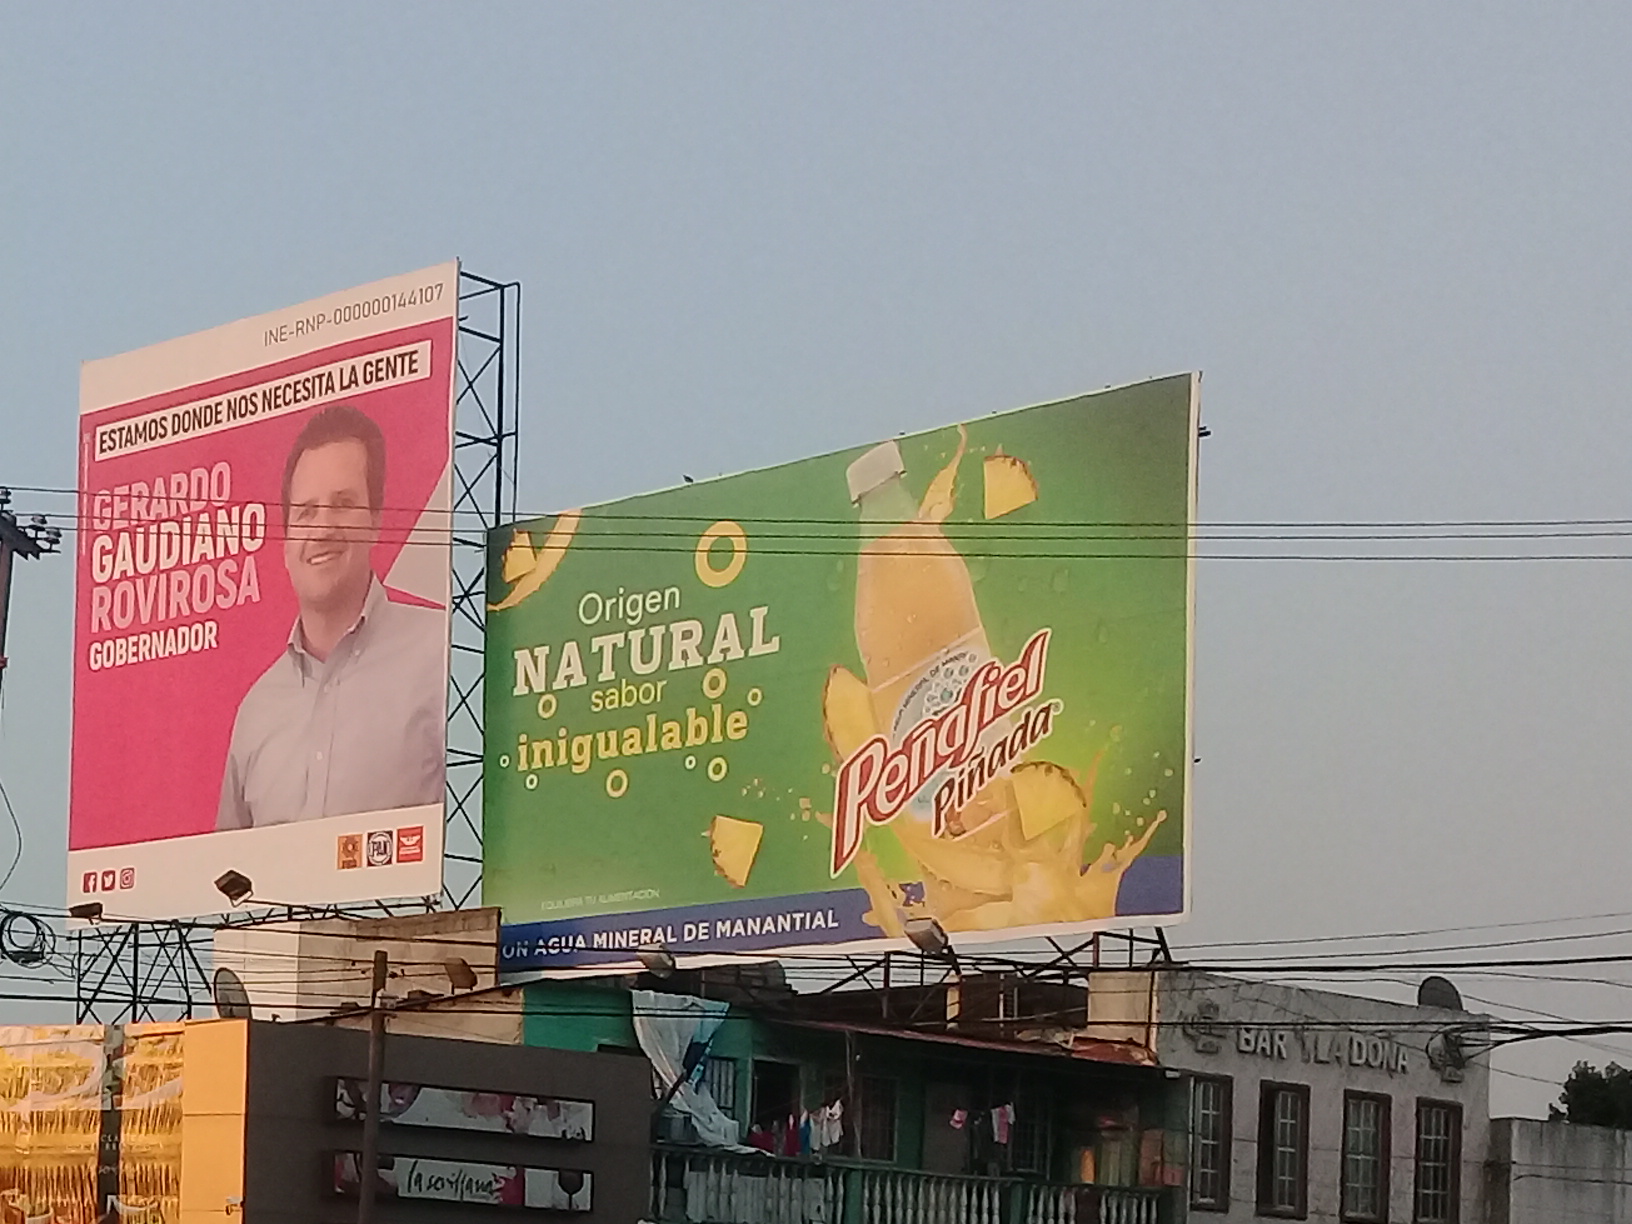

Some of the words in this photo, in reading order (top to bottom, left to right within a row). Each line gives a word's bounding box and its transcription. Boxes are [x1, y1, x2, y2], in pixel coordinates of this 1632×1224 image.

[264, 283, 443, 346] INE-RNP-000000144107
[99, 415, 168, 455] ESTAMOS
[171, 400, 224, 437] DONDE
[226, 393, 259, 423] NOS
[262, 373, 335, 412] NECESITA
[339, 367, 359, 391] LA
[363, 350, 419, 385] GENTE
[93, 461, 232, 532] GERARDO
[91, 502, 267, 584] GAUDIANO
[90, 555, 261, 635] ROVIROSA
[579, 586, 681, 625] Origen
[88, 622, 218, 671] GOBERNADOR
[512, 606, 780, 697] NATURAL
[591, 679, 668, 713] sabor
[517, 703, 749, 773] inigualable
[934, 702, 1052, 837] Piñada
[534, 935, 587, 956] AGUA
[593, 926, 678, 950] MINERAL
[683, 921, 710, 942] DE
[715, 910, 840, 939] MANANTIAL
[1237, 1027, 1287, 1059] BAR
